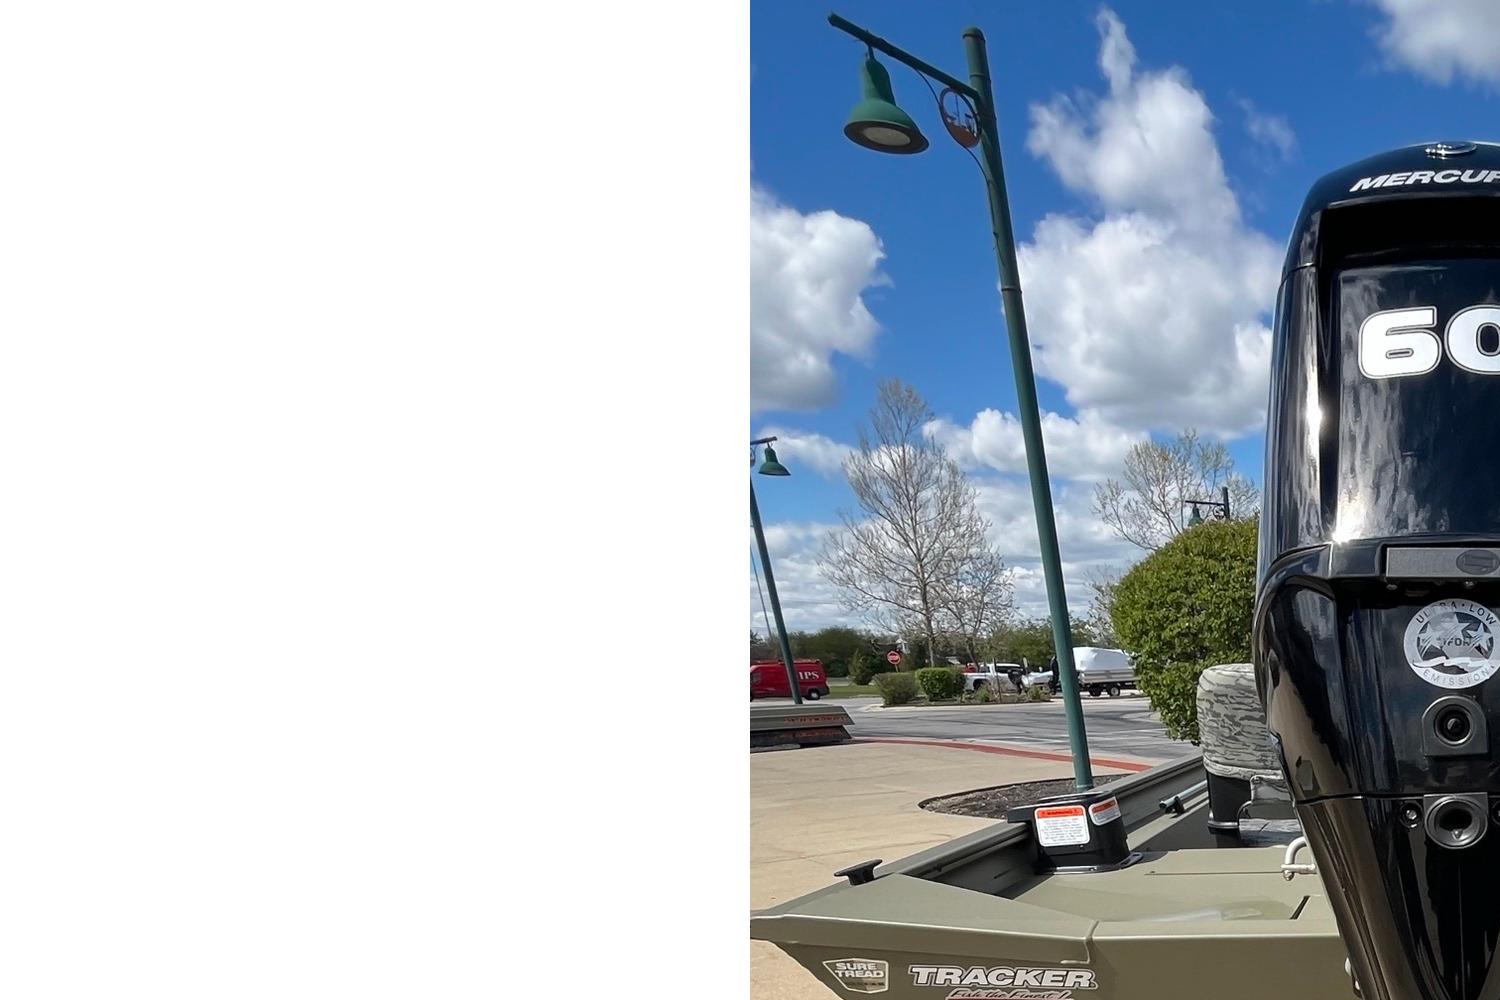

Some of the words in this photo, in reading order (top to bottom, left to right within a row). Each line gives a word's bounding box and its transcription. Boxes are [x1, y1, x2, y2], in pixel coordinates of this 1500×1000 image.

[1416, 601, 1458, 624] ULRA
[835, 962, 877, 971] SURE
[835, 970, 885, 978] TREAD
[910, 966, 1094, 989] TRACKER
